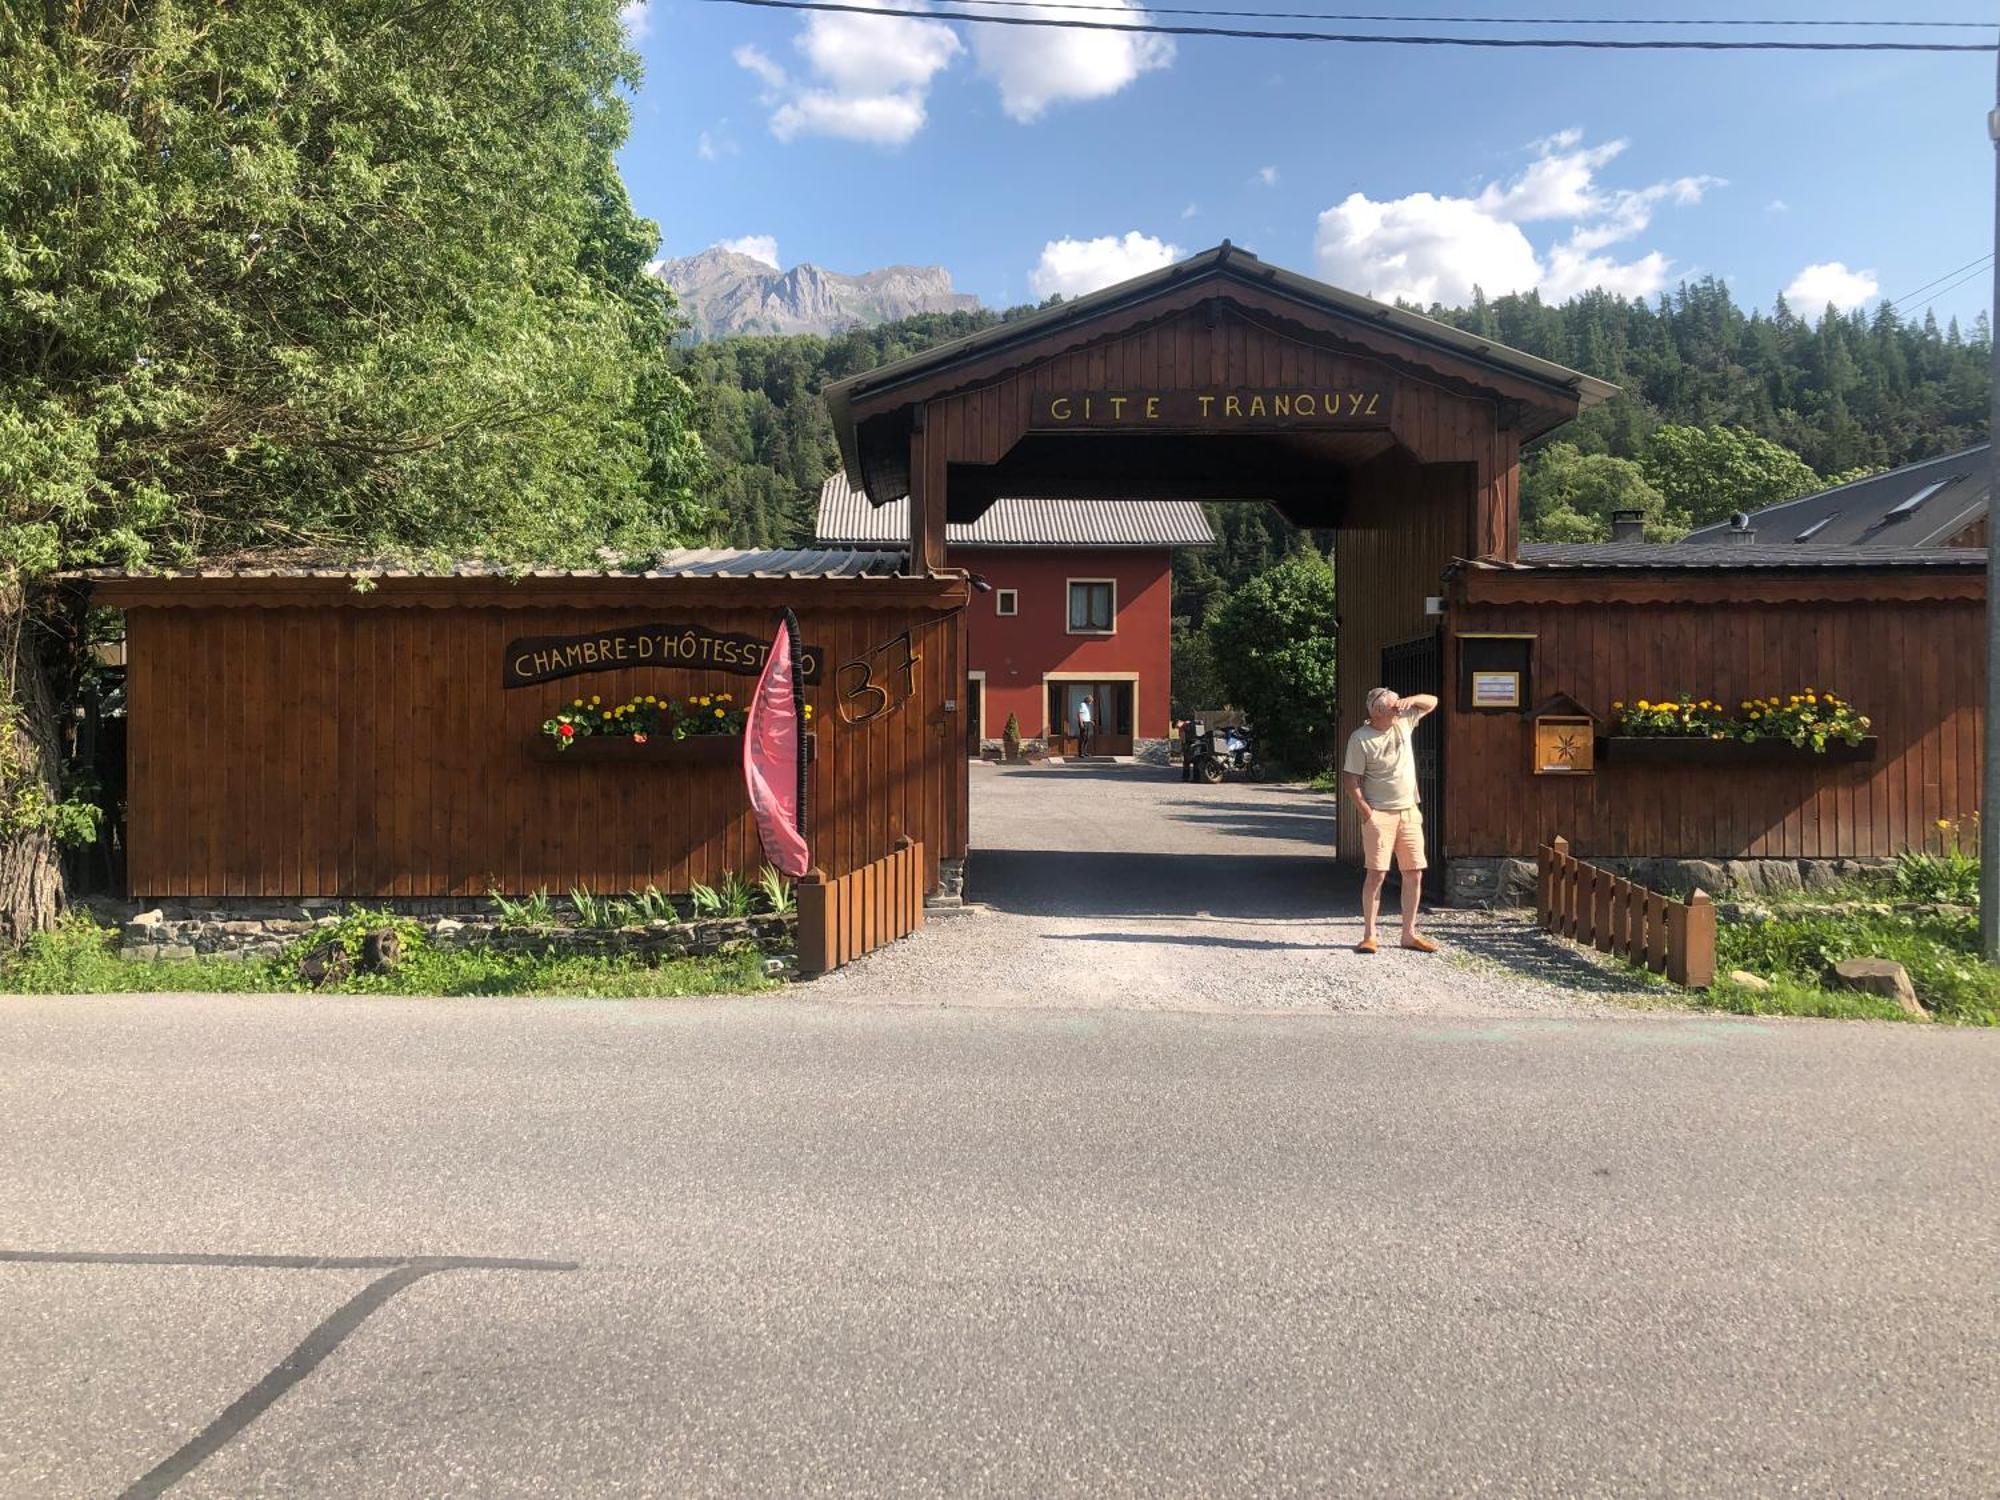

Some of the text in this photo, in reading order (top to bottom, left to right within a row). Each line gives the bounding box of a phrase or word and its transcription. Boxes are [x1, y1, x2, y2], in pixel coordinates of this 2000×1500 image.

[1050, 393, 1381, 421] GITE TRANQUYL
[514, 631, 816, 678] CHAMBRE-D'HÔTES-STO
[837, 630, 922, 724] 37
